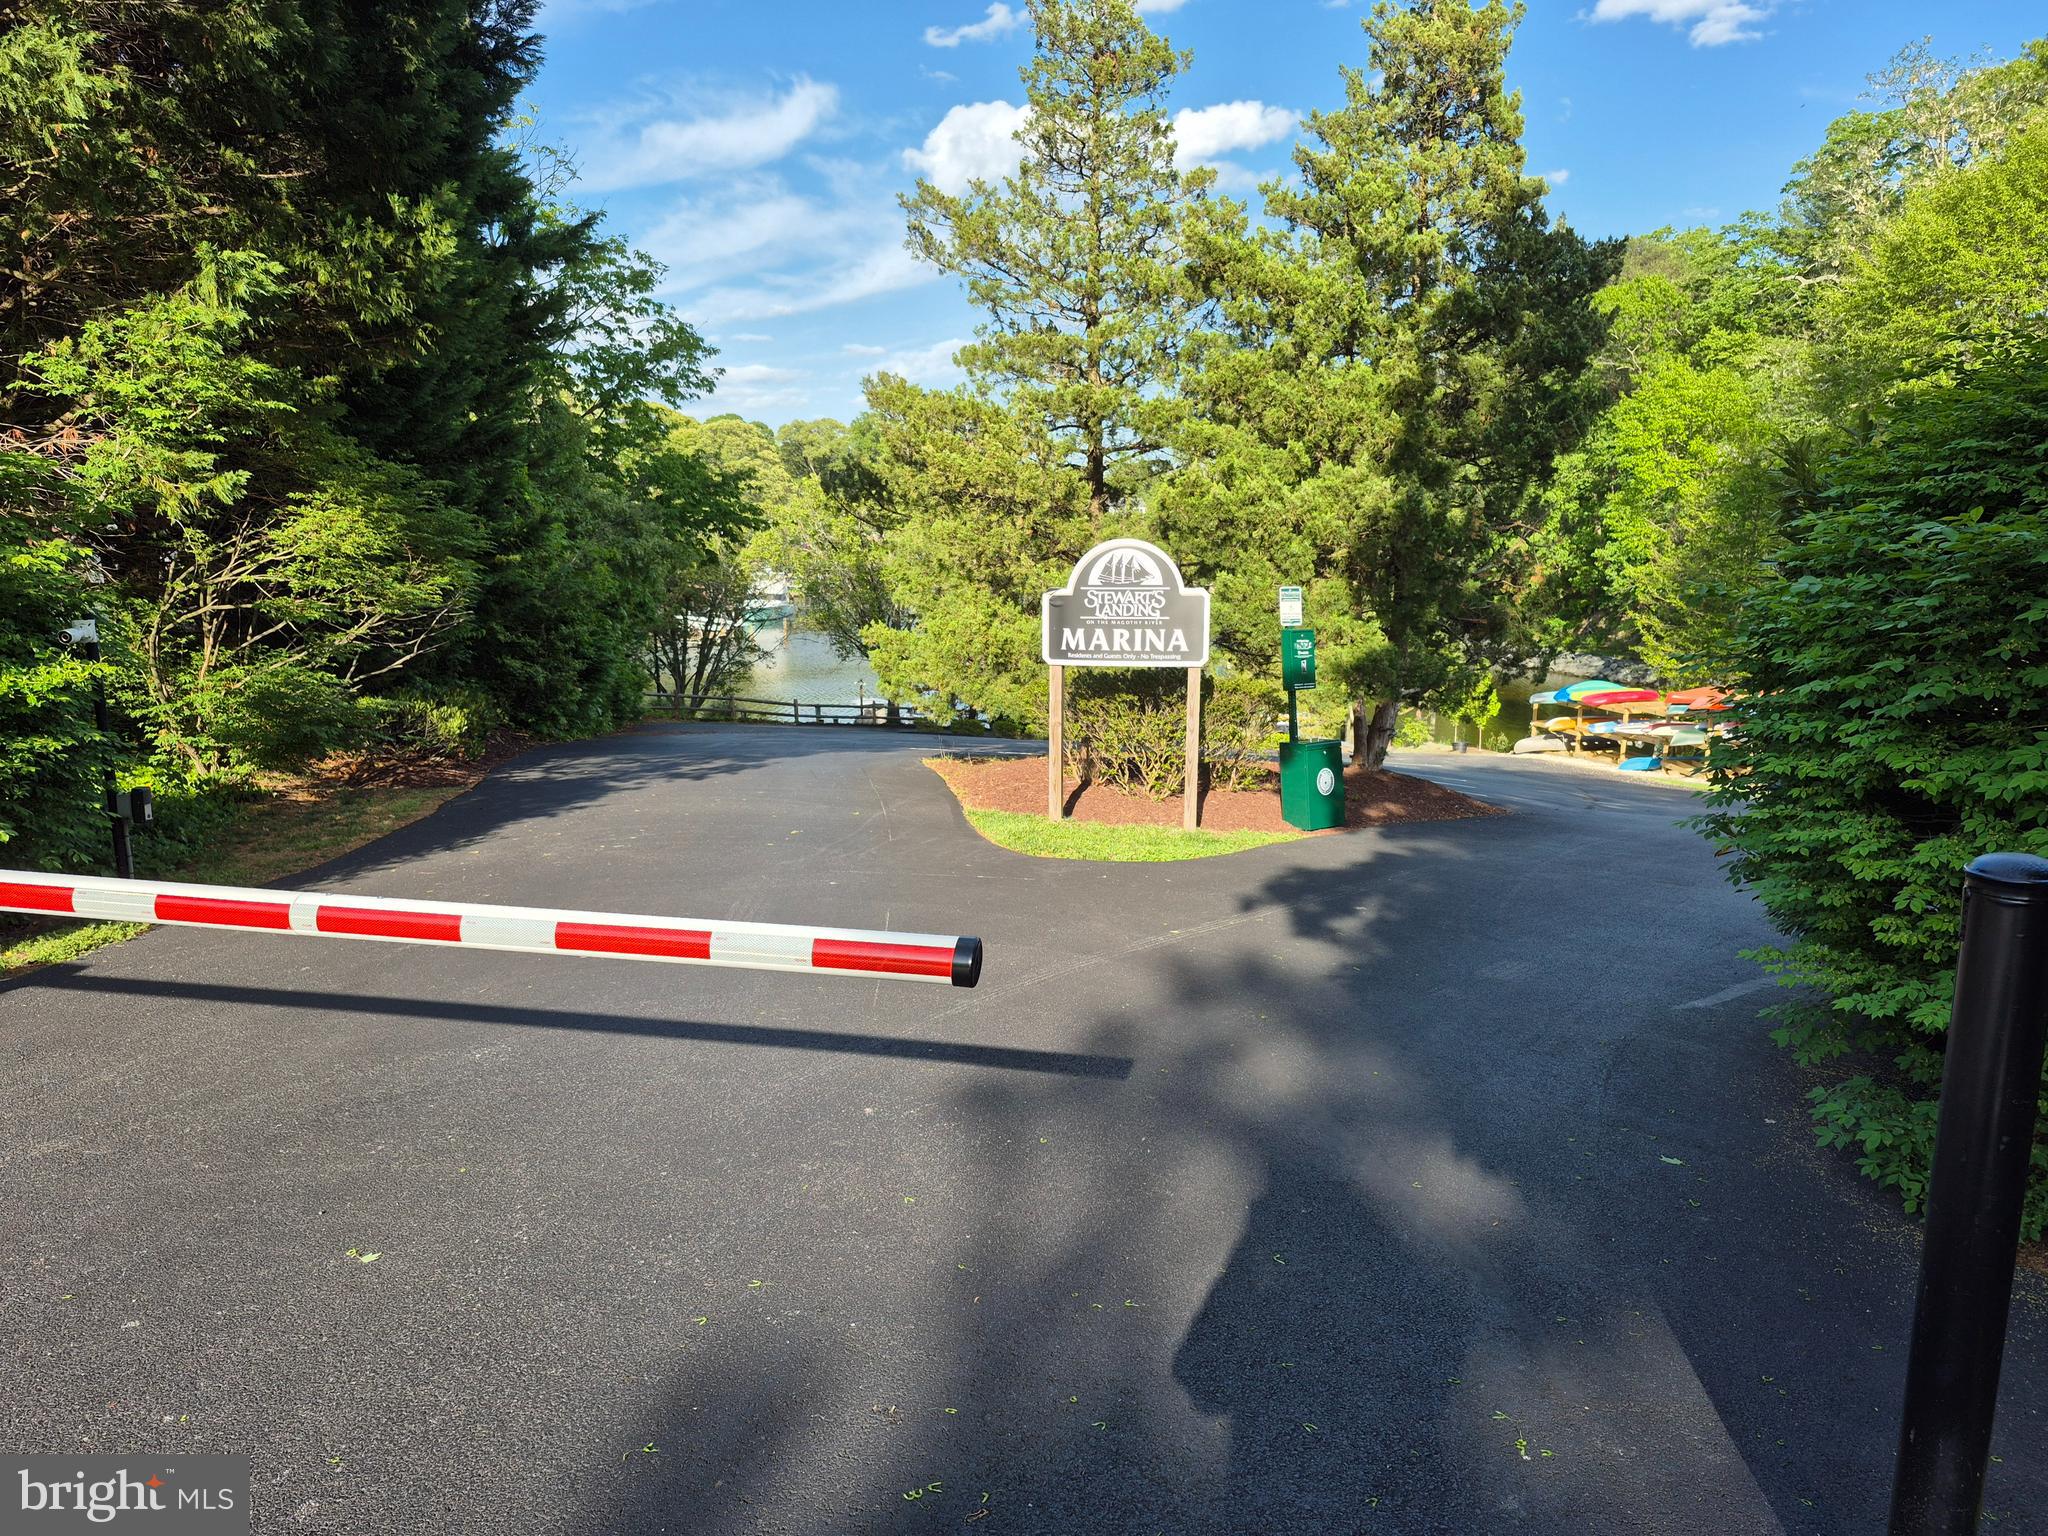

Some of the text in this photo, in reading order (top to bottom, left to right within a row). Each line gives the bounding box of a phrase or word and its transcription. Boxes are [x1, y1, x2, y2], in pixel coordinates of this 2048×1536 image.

[1084, 590, 1166, 608] STEWART'S
[1094, 603, 1160, 618] LANDING
[1060, 627, 1190, 652] MARINA
[1122, 653, 1136, 661] Only
[1150, 653, 1182, 661] Trespassing
